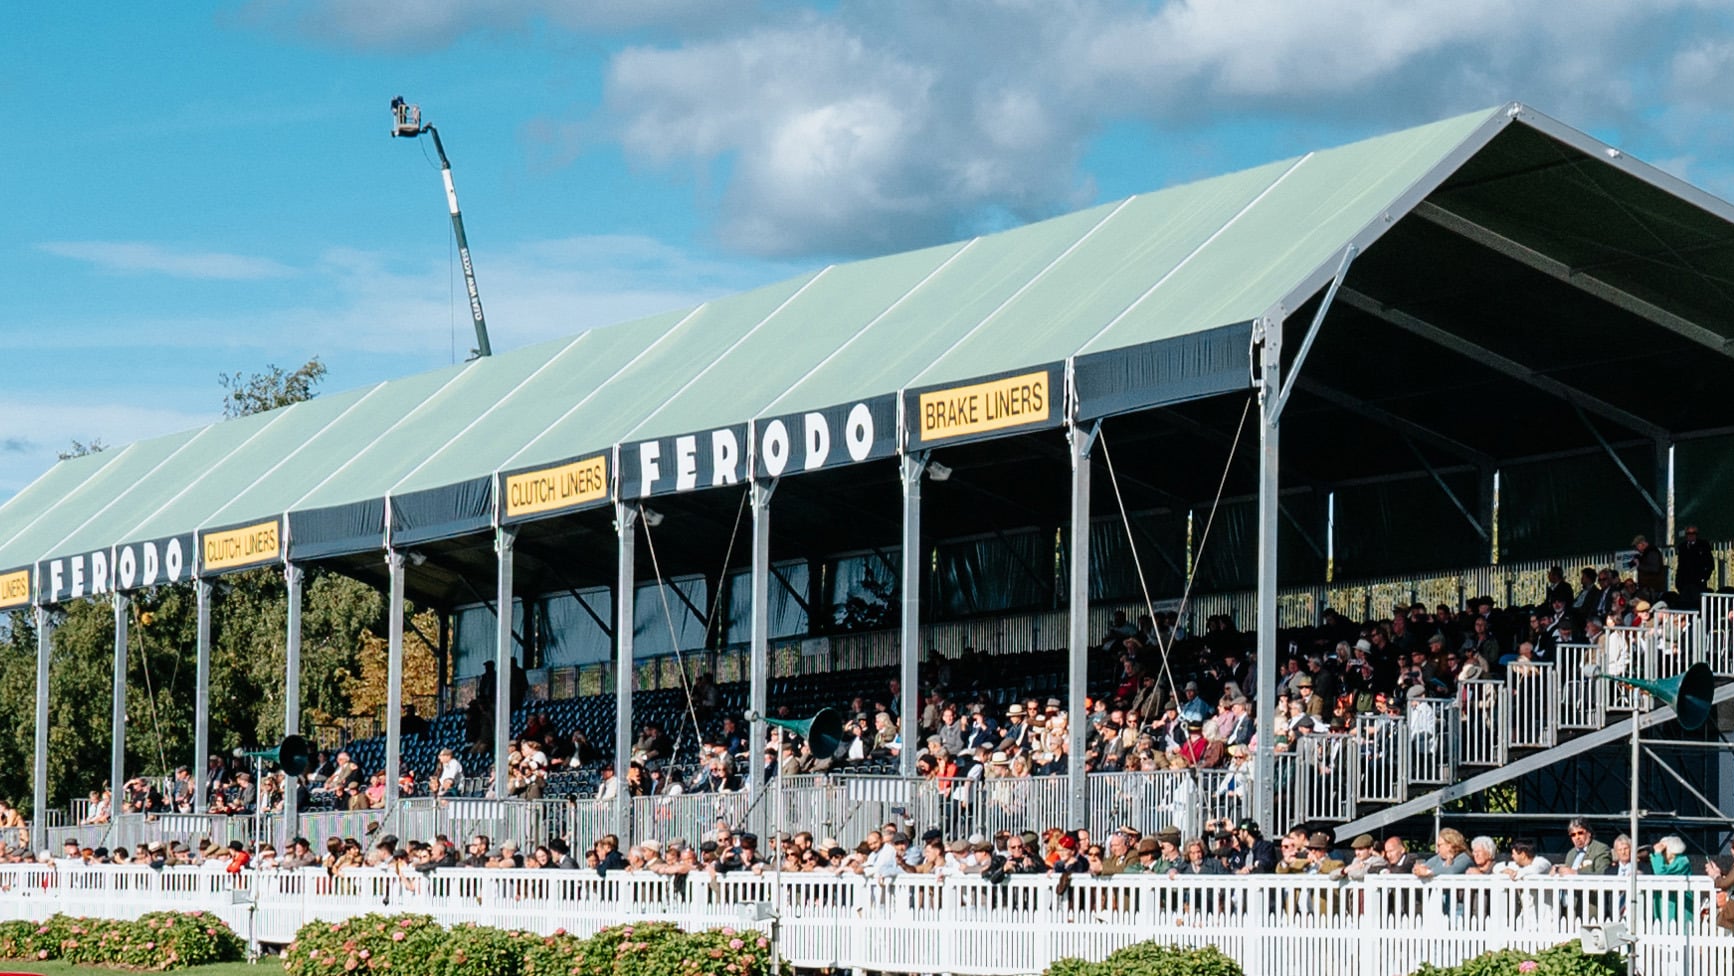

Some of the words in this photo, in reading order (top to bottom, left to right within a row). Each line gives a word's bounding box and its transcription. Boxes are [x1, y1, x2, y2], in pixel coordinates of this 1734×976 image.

[926, 395, 978, 430] BRAKE
[985, 382, 1043, 420] LINERS
[640, 402, 874, 498] FERODO
[511, 478, 555, 507] CLUTCH
[561, 465, 602, 498] LINERS
[207, 537, 241, 562] CLUTCH
[244, 529, 276, 554] LINERS
[50, 538, 182, 602] FERODO
